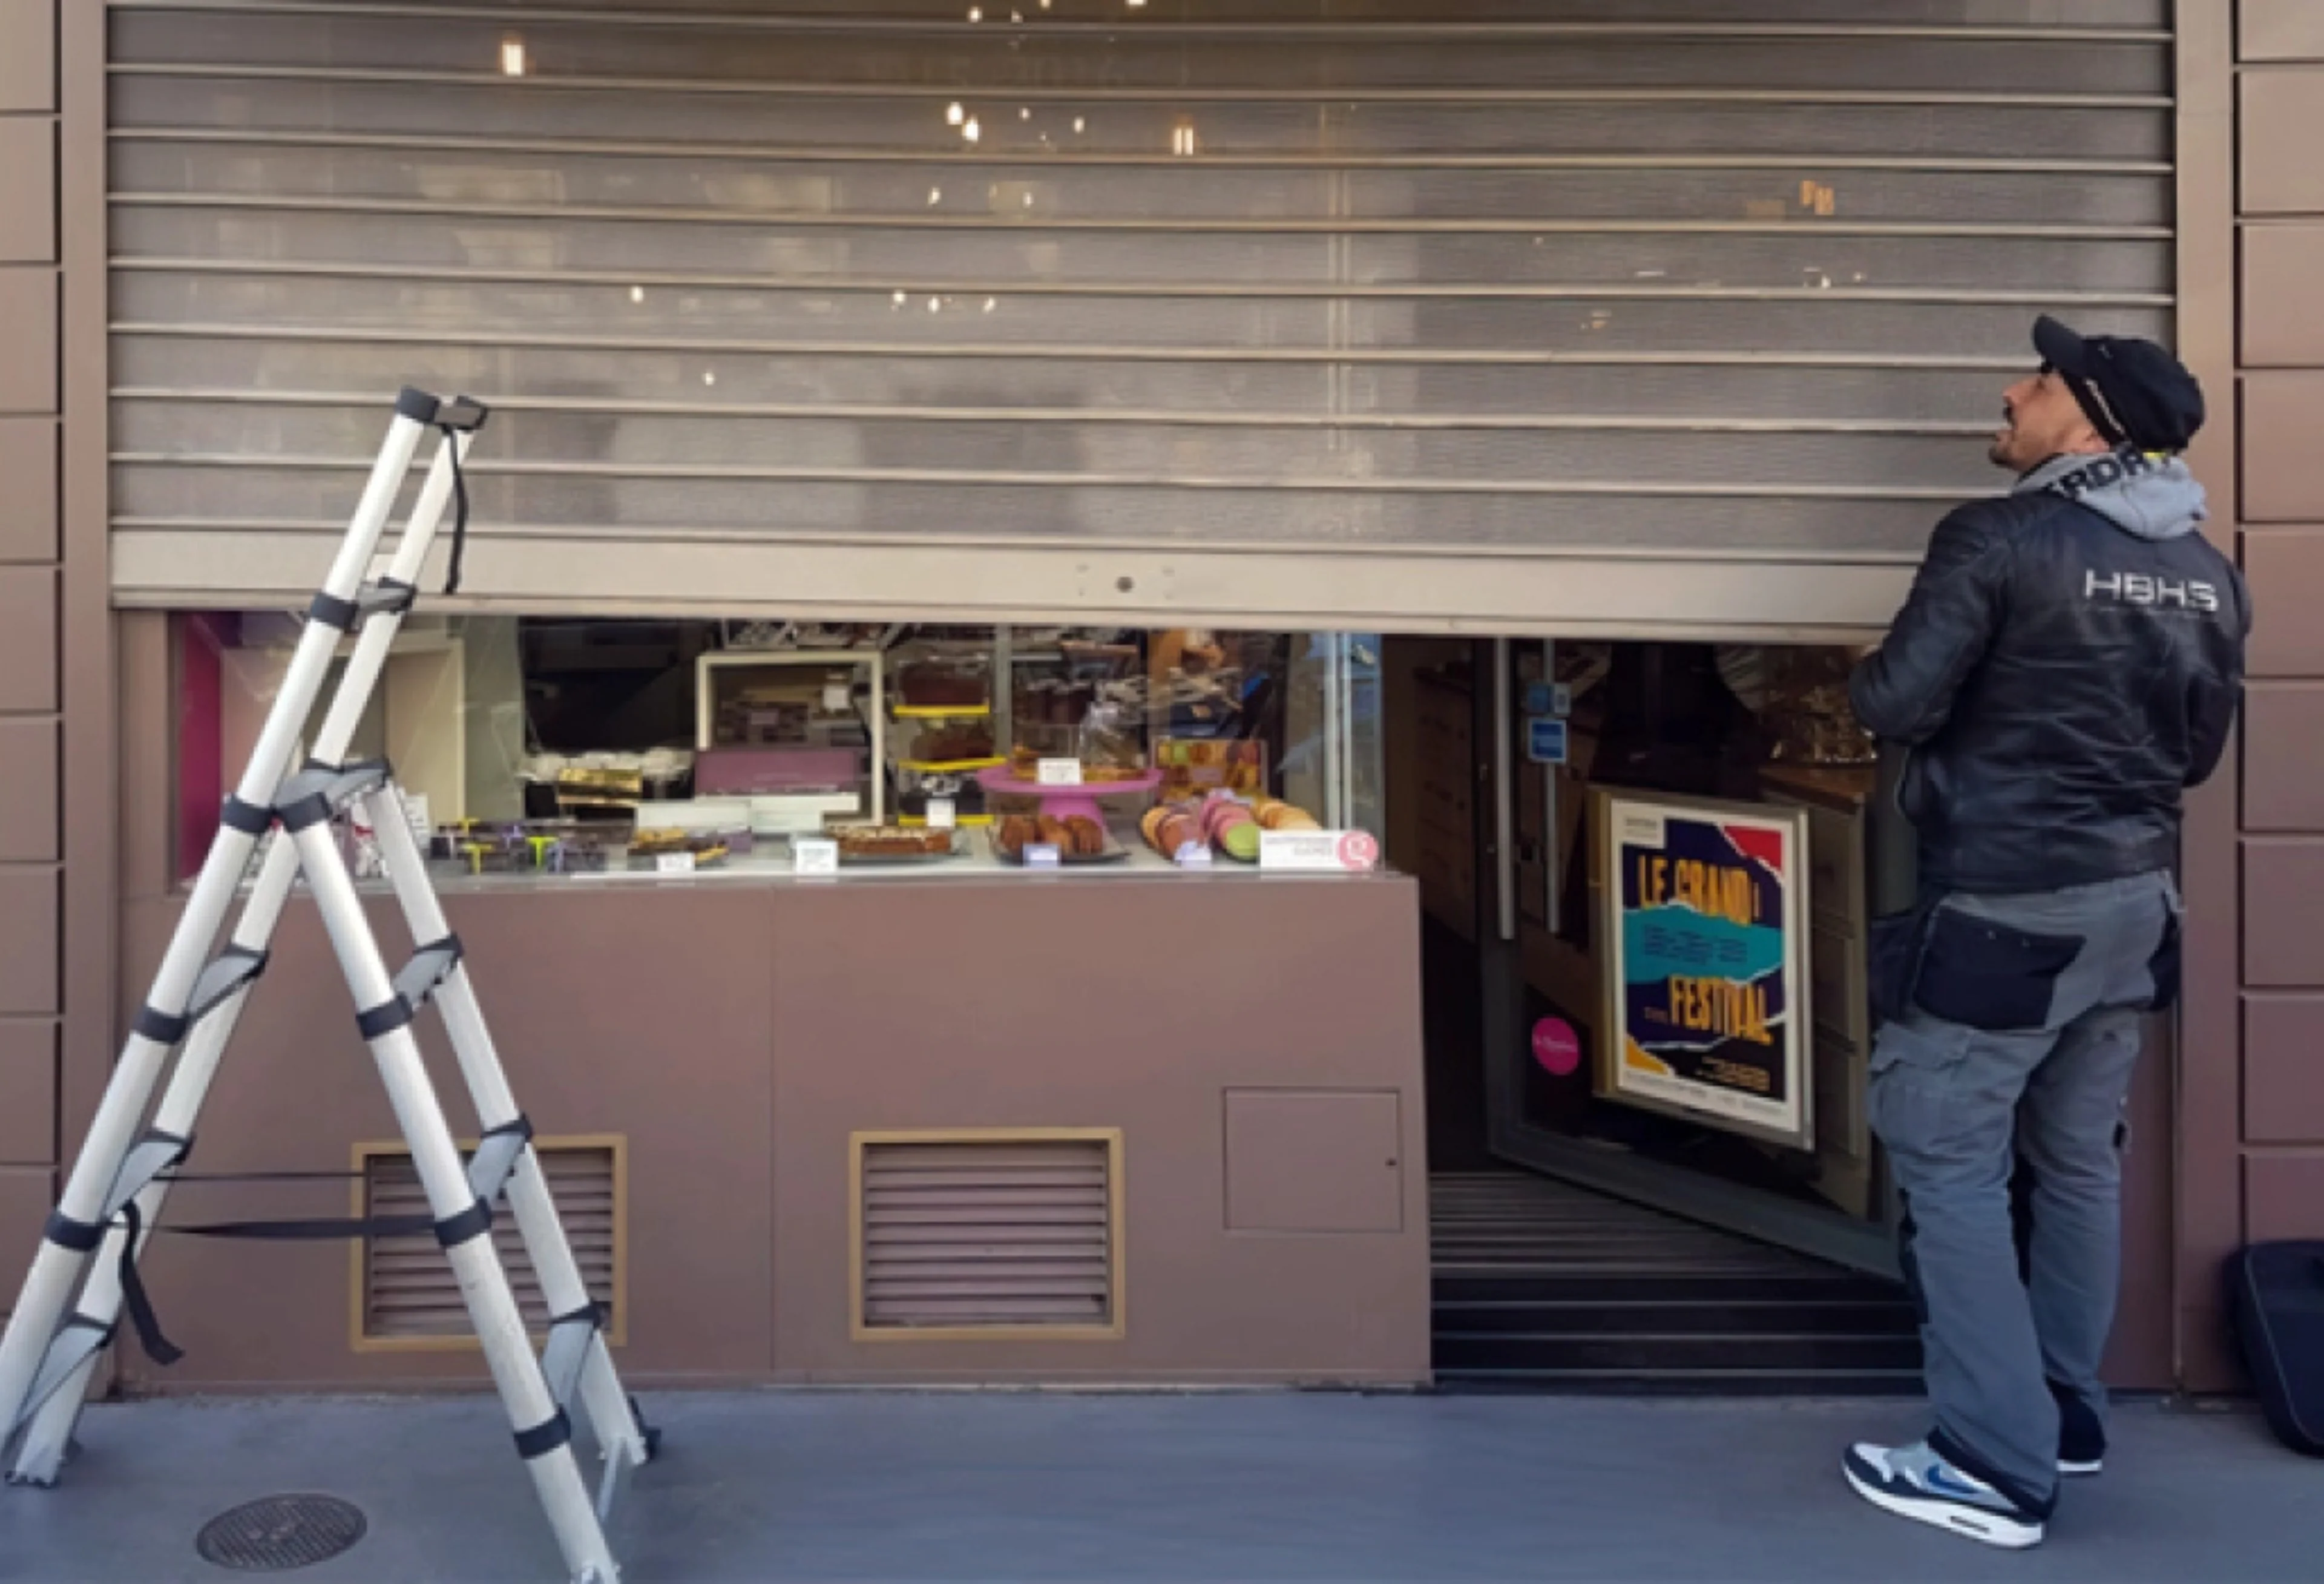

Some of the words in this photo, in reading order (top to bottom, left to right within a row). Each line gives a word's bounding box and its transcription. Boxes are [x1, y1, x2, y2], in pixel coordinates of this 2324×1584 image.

[1638, 855, 1668, 909] LE
[1675, 858, 1751, 927] GRAND
[1670, 975, 1773, 1045] FESTIVAL
